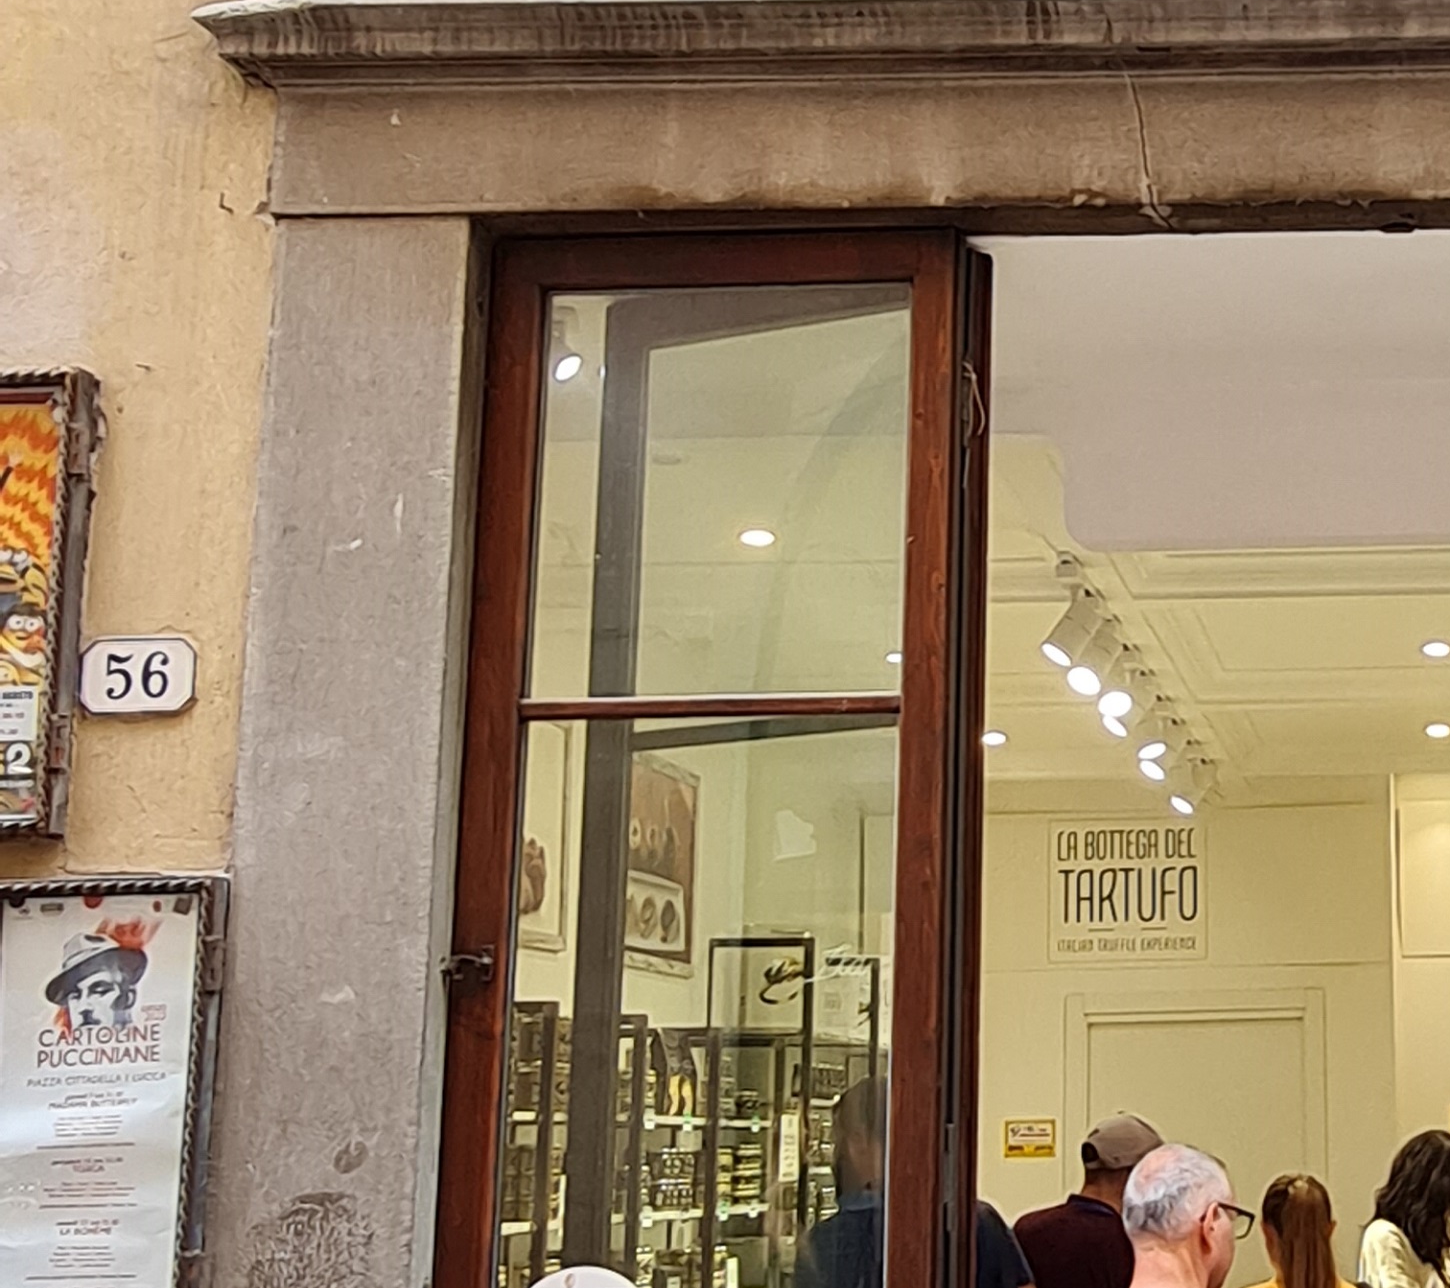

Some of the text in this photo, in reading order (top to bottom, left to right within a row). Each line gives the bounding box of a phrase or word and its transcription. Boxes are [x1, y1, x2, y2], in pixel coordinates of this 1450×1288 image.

[104, 650, 170, 701] 56
[1057, 827, 1197, 862] LA BOTTEGA DEL
[1058, 865, 1198, 924] TARTUFO
[38, 1023, 161, 1048] CARTOLINE
[36, 1044, 161, 1069] PUCCINIANE
